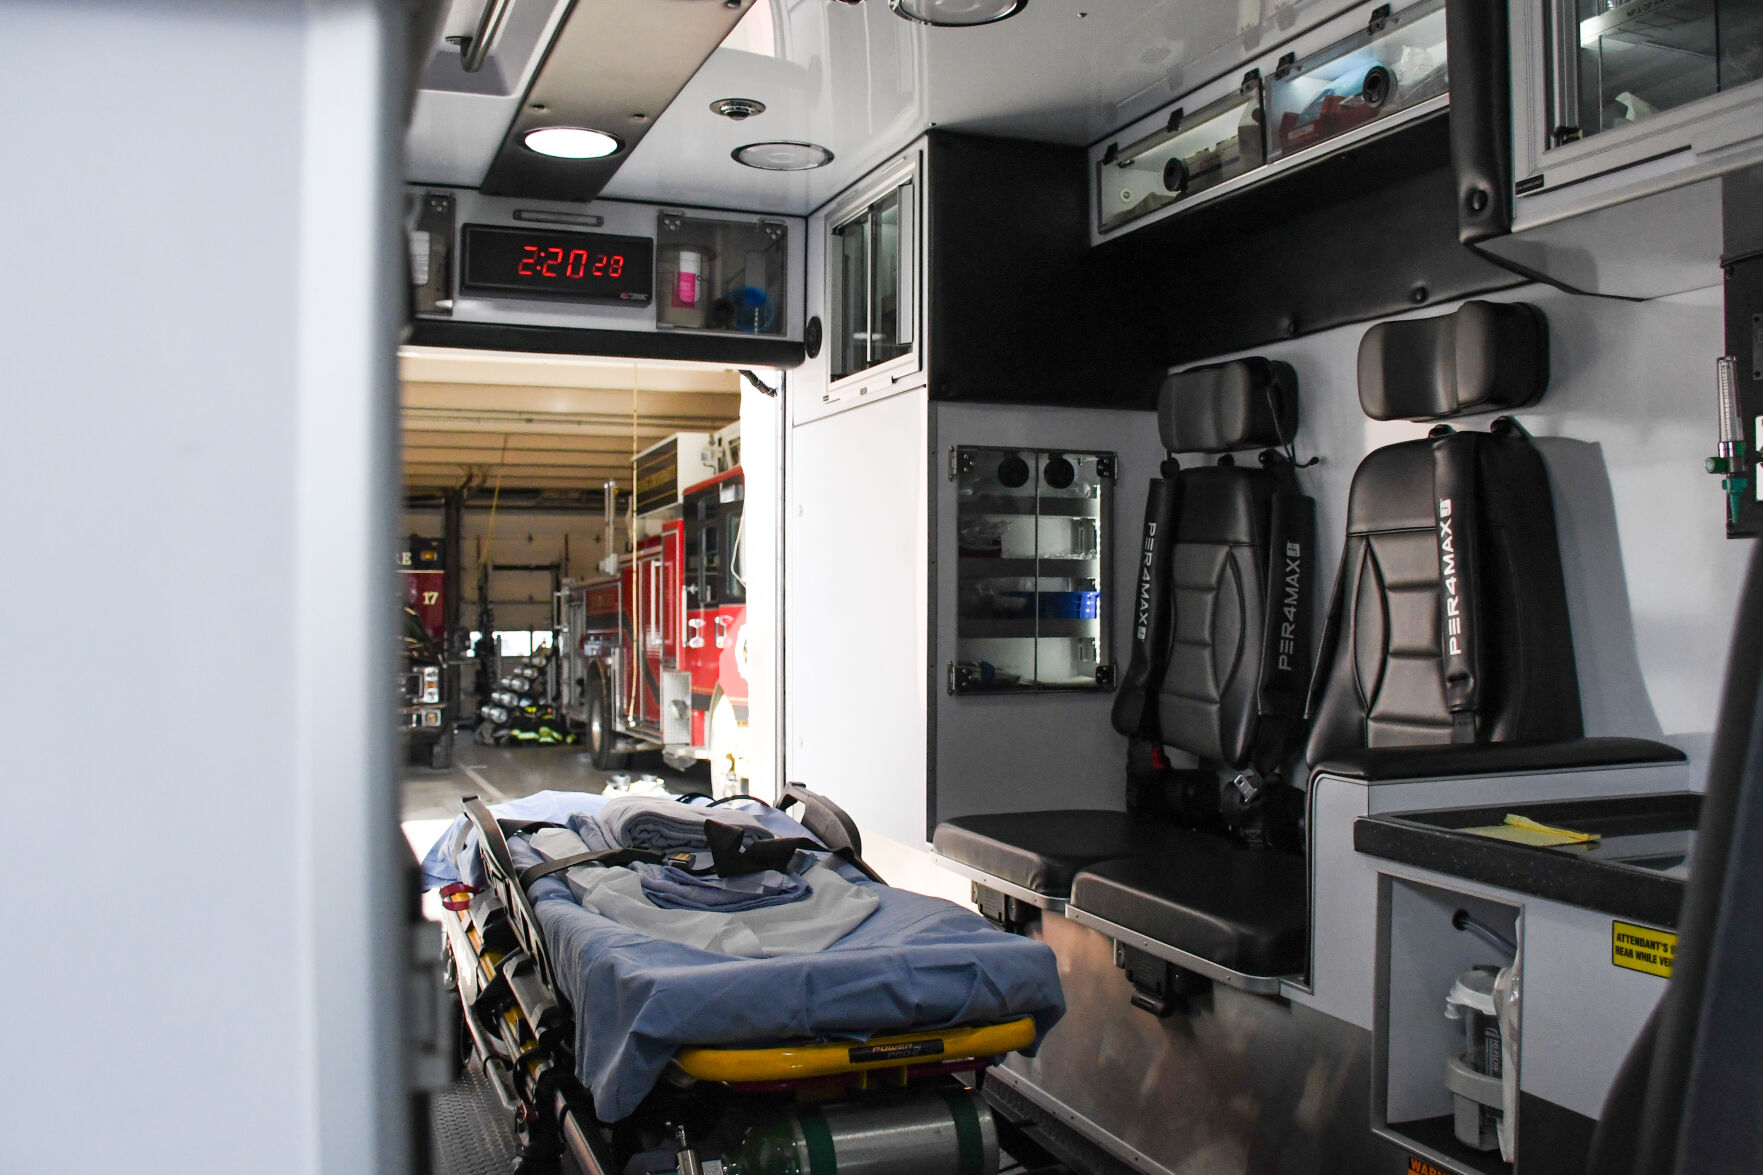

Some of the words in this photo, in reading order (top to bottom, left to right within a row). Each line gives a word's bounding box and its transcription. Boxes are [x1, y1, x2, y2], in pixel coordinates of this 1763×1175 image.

[519, 246, 588, 279] 2:20
[592, 255, 624, 278] 28
[1139, 522, 1157, 625] PER4MAX
[1440, 518, 1462, 656] PER4MAX
[423, 591, 439, 606] 17
[1278, 558, 1300, 671] PER4MAX
[1615, 945, 1633, 959] REAR
[1635, 950, 1657, 964] WHILE
[1616, 932, 1668, 953] ATTENDANT'S
